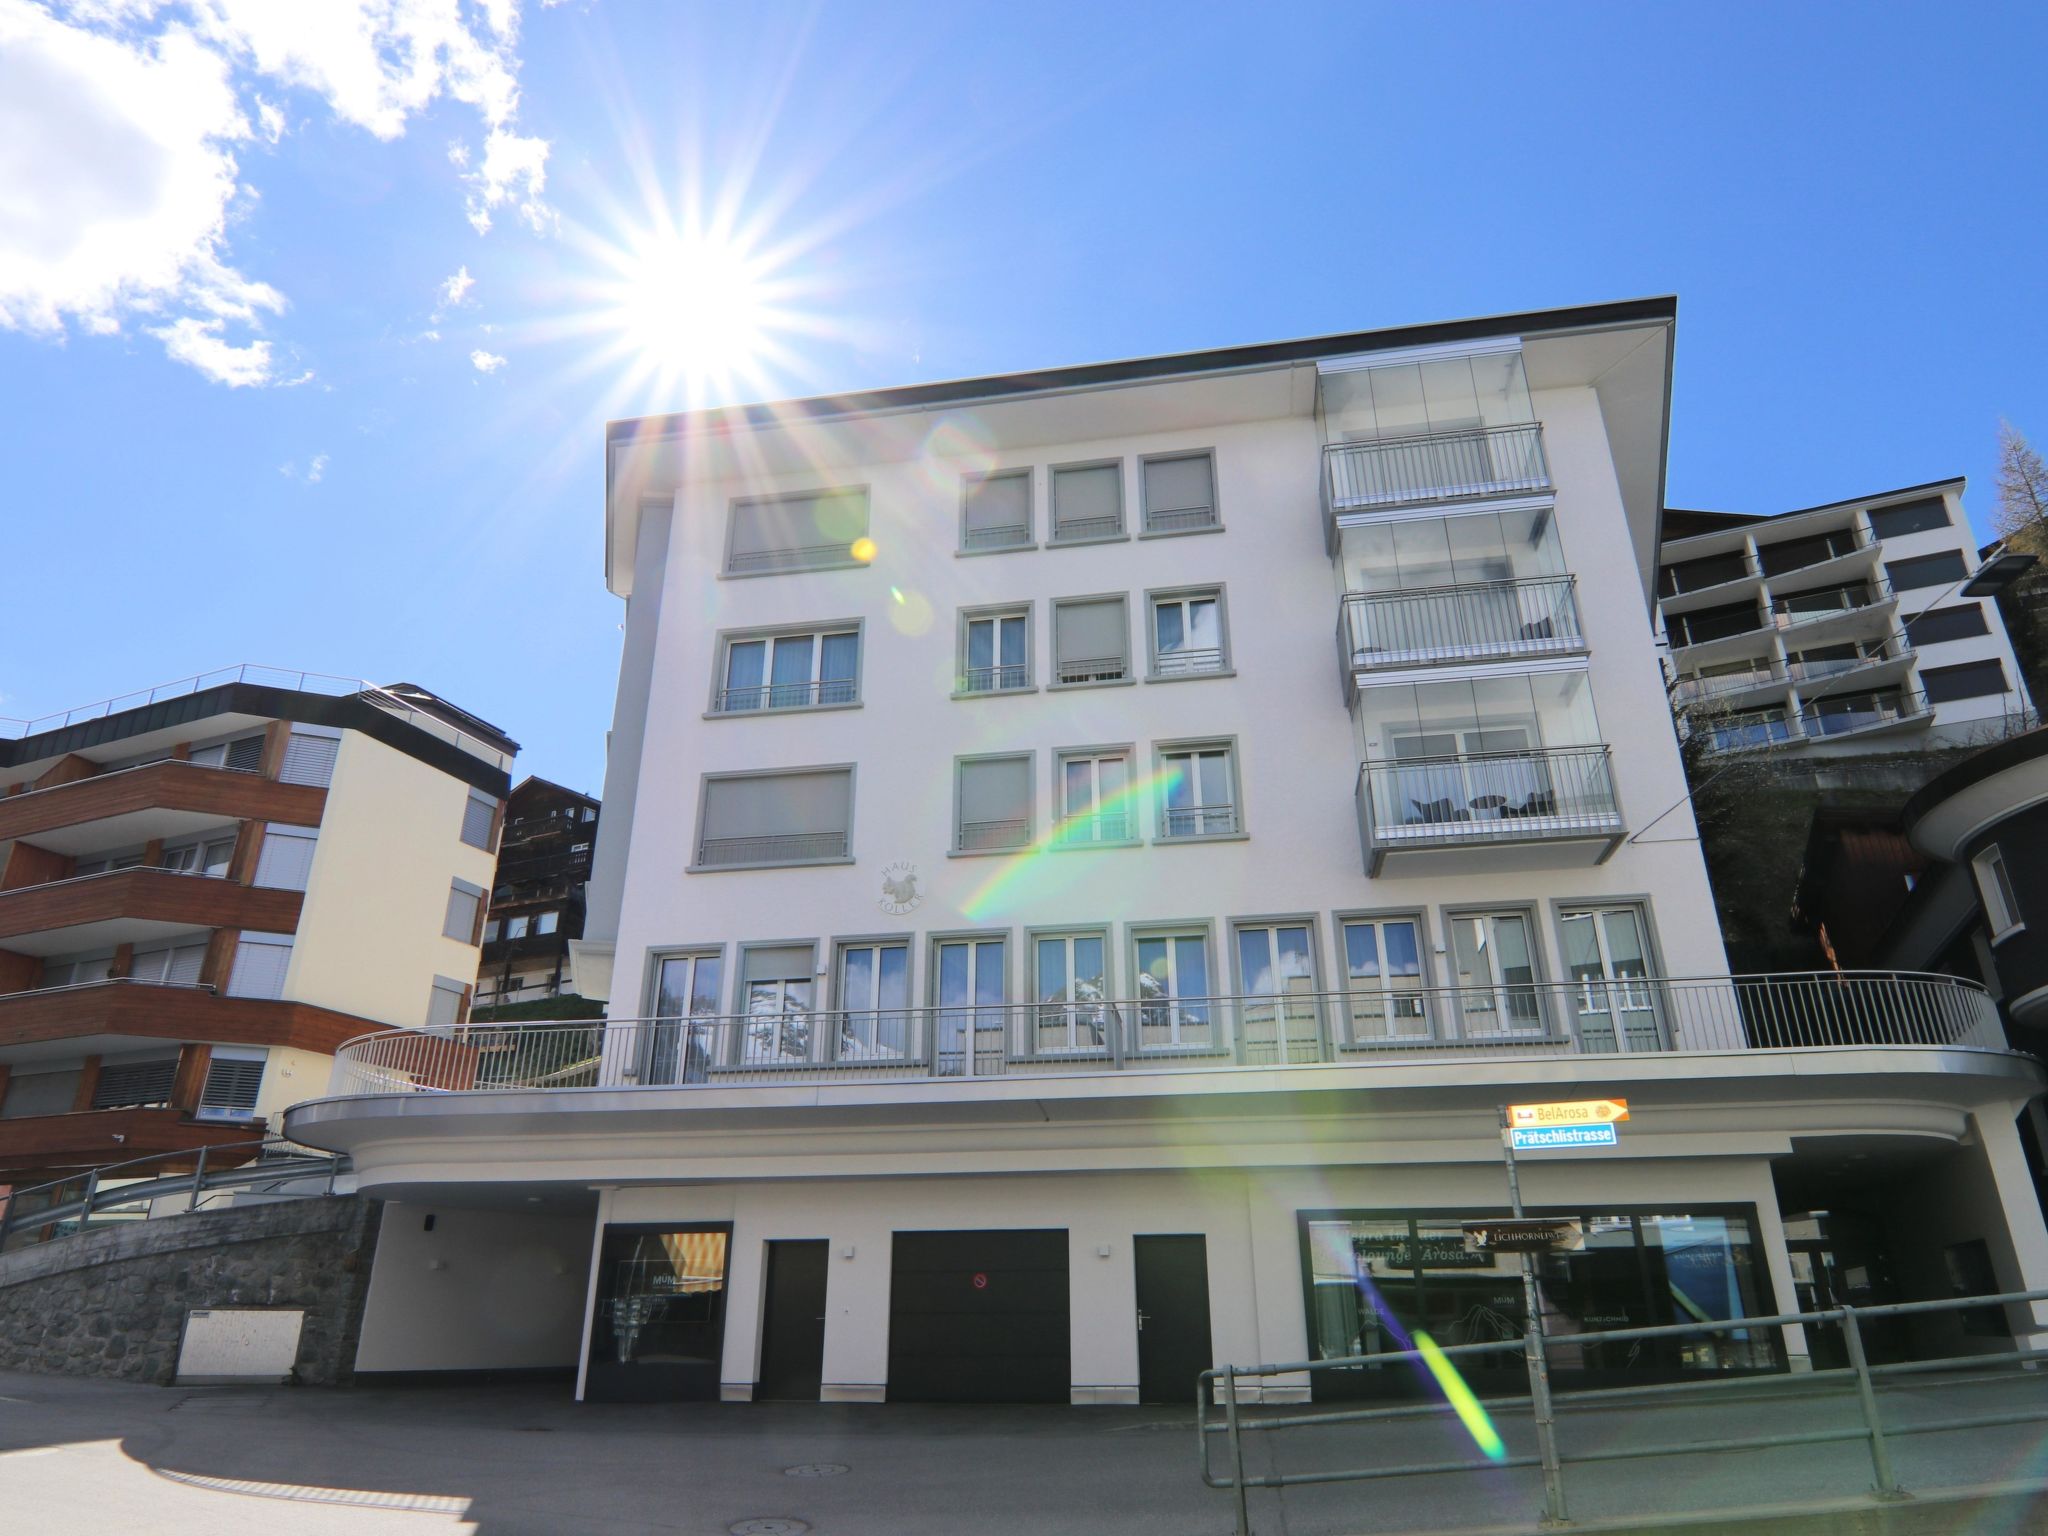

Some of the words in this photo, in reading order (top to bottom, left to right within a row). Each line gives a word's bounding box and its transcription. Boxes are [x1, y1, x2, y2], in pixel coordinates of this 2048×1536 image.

[881, 862, 918, 877] HAUS
[878, 894, 924, 914] KOLLER
[1537, 1107, 1589, 1121] BelArosa
[1515, 1129, 1611, 1145] Prätschlistrasse
